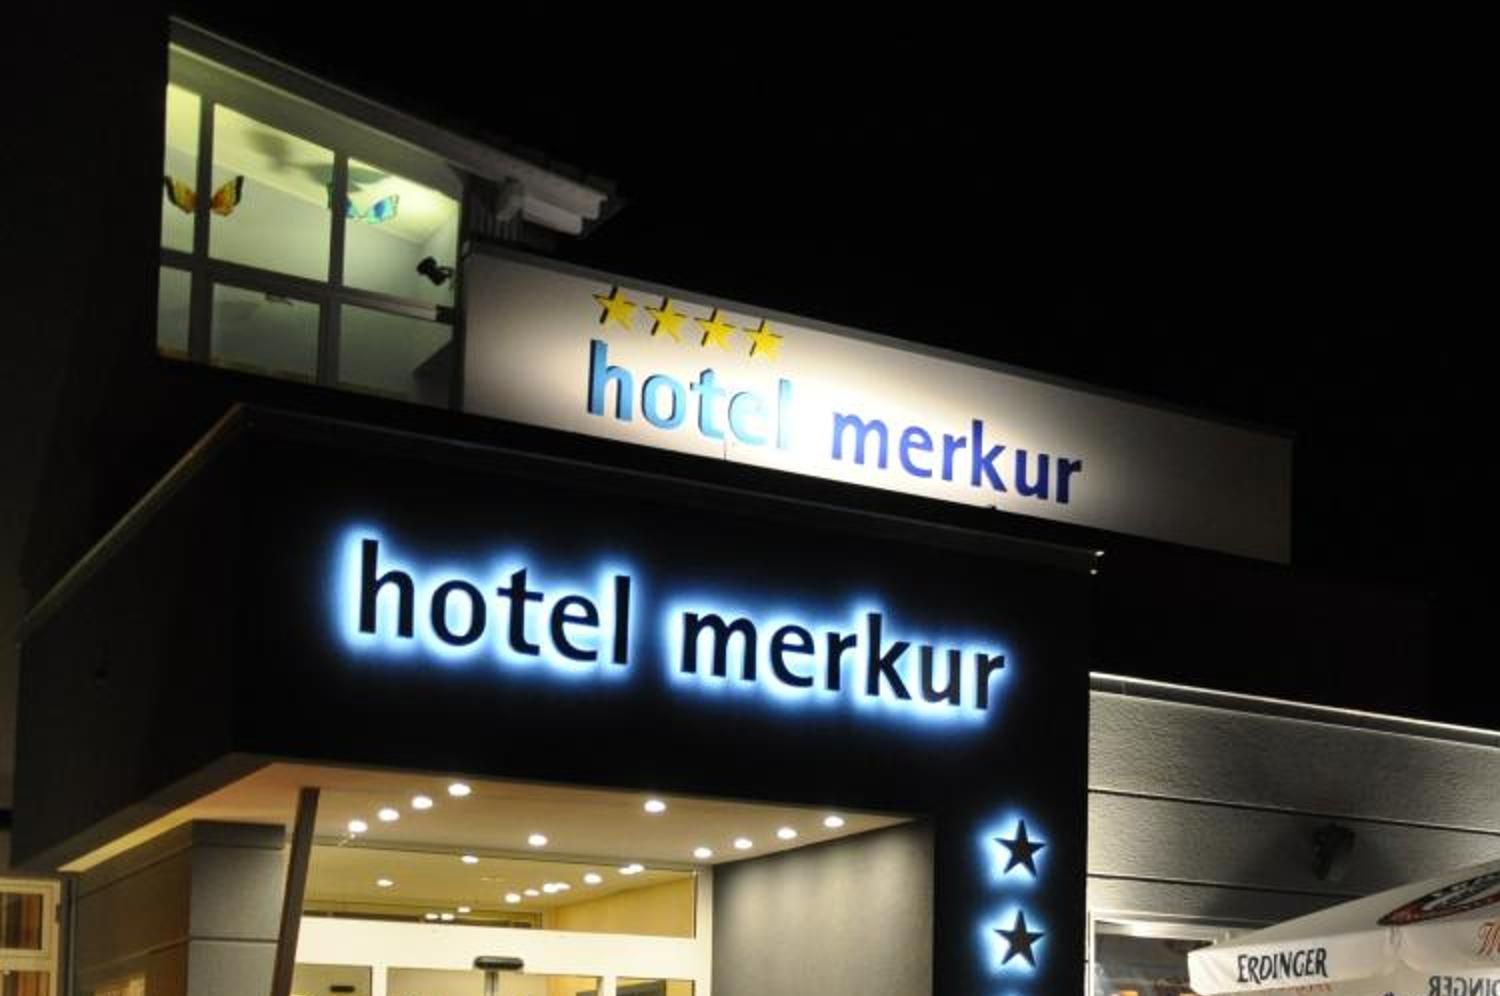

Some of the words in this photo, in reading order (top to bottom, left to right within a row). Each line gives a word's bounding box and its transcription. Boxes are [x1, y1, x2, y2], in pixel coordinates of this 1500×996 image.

[587, 338, 793, 450] hotel
[831, 411, 1082, 504] merkur
[357, 538, 632, 666] hotel
[679, 610, 1006, 711] merkur
[1236, 947, 1329, 984] ERDINGER
